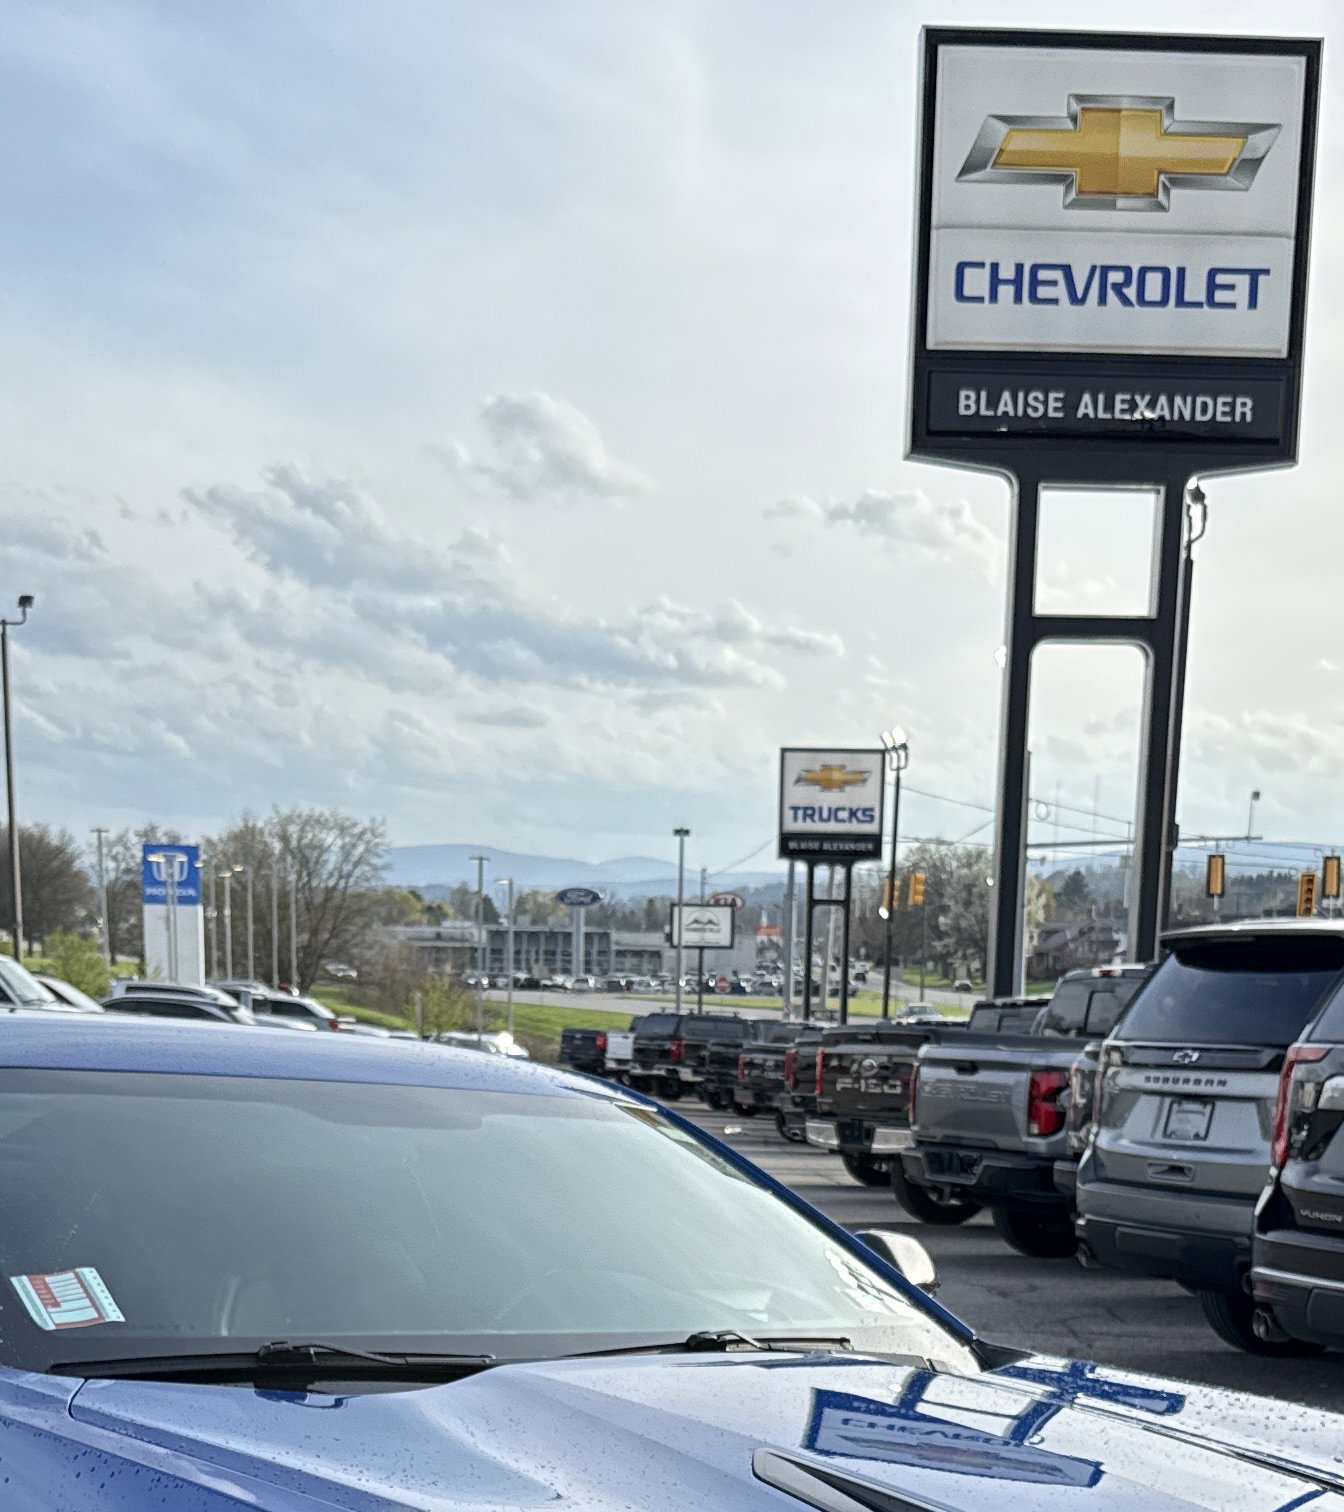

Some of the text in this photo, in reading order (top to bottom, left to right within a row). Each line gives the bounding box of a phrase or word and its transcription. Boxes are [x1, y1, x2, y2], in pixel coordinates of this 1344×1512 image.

[954, 261, 1271, 311] CHEVROLET
[958, 388, 1255, 423] BLAISE ALEXANDER
[788, 806, 875, 824] TRUCKS
[1144, 1075, 1228, 1088] SUBURBAN
